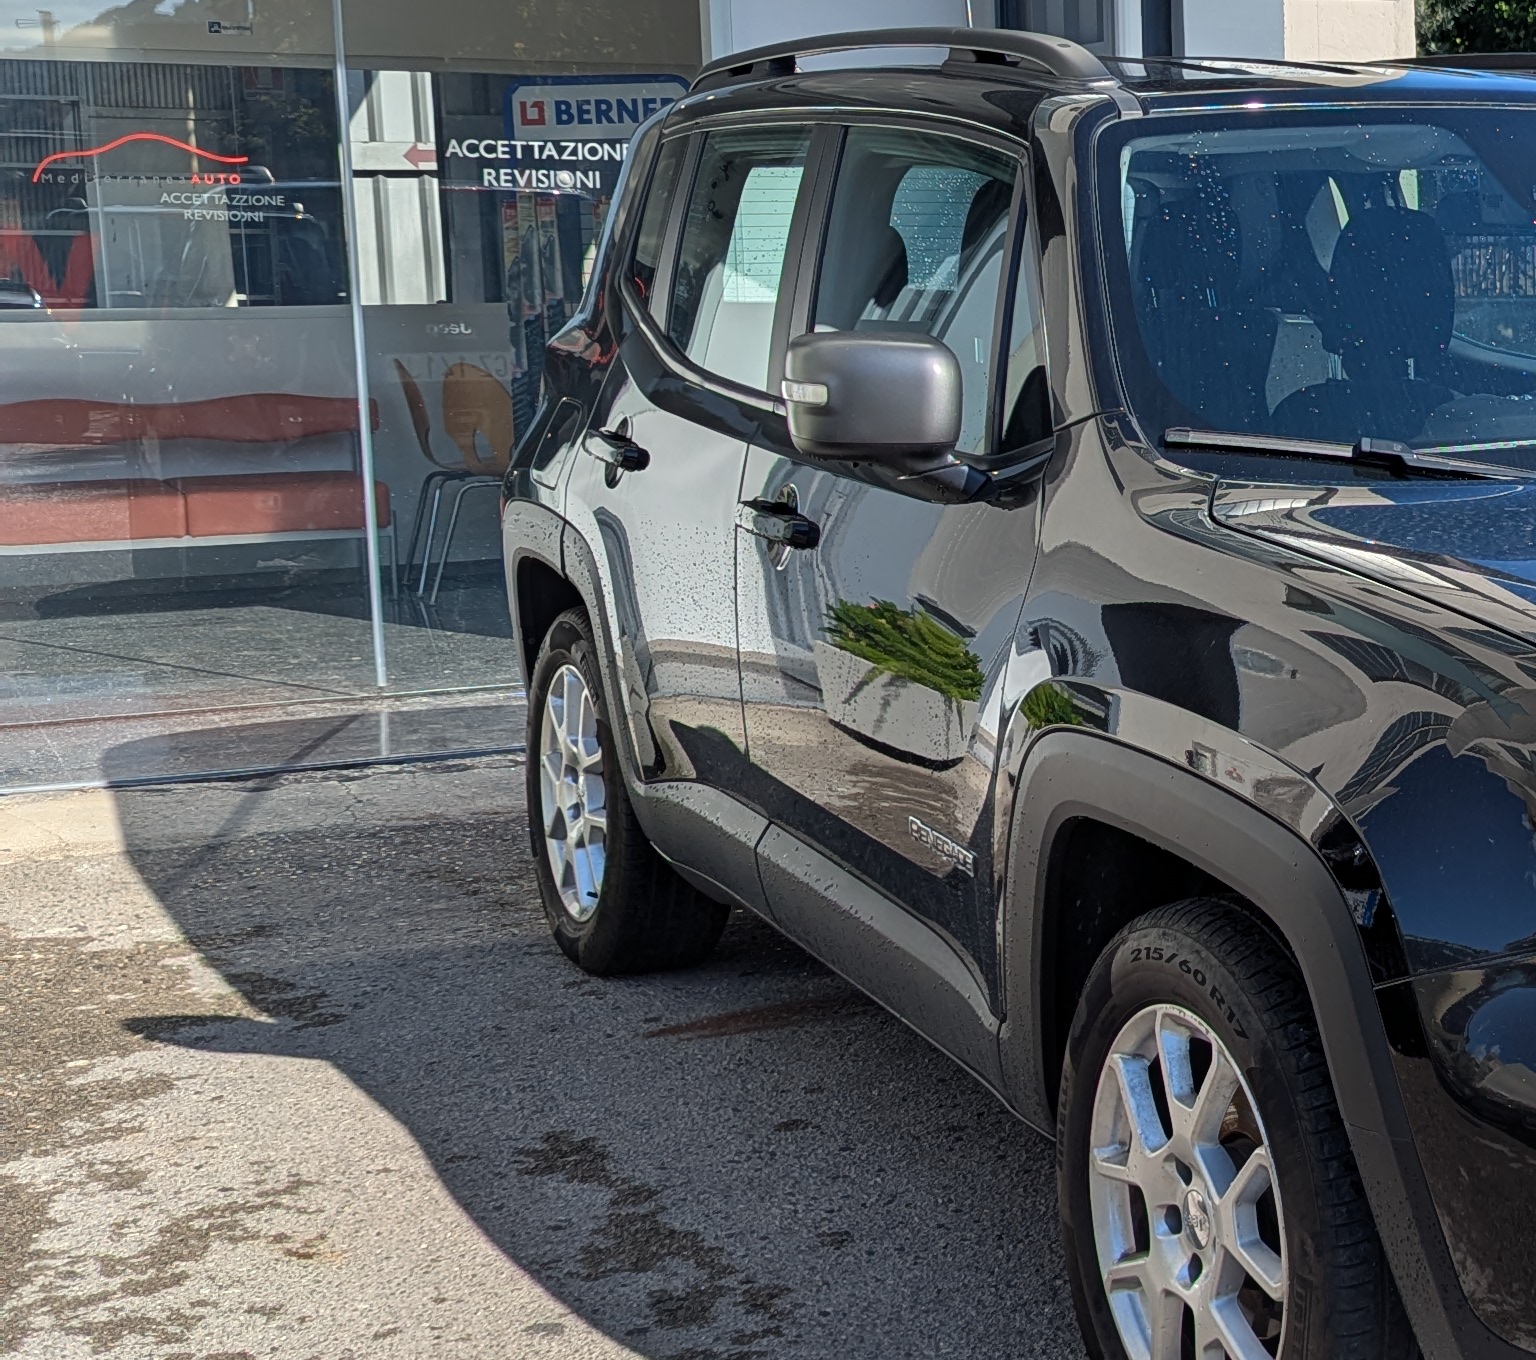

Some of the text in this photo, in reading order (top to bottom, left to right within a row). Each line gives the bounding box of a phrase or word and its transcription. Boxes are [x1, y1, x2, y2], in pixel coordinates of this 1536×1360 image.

[483, 168, 601, 189] REVISIONI
[1130, 945, 1250, 1041] 215/60 R17
